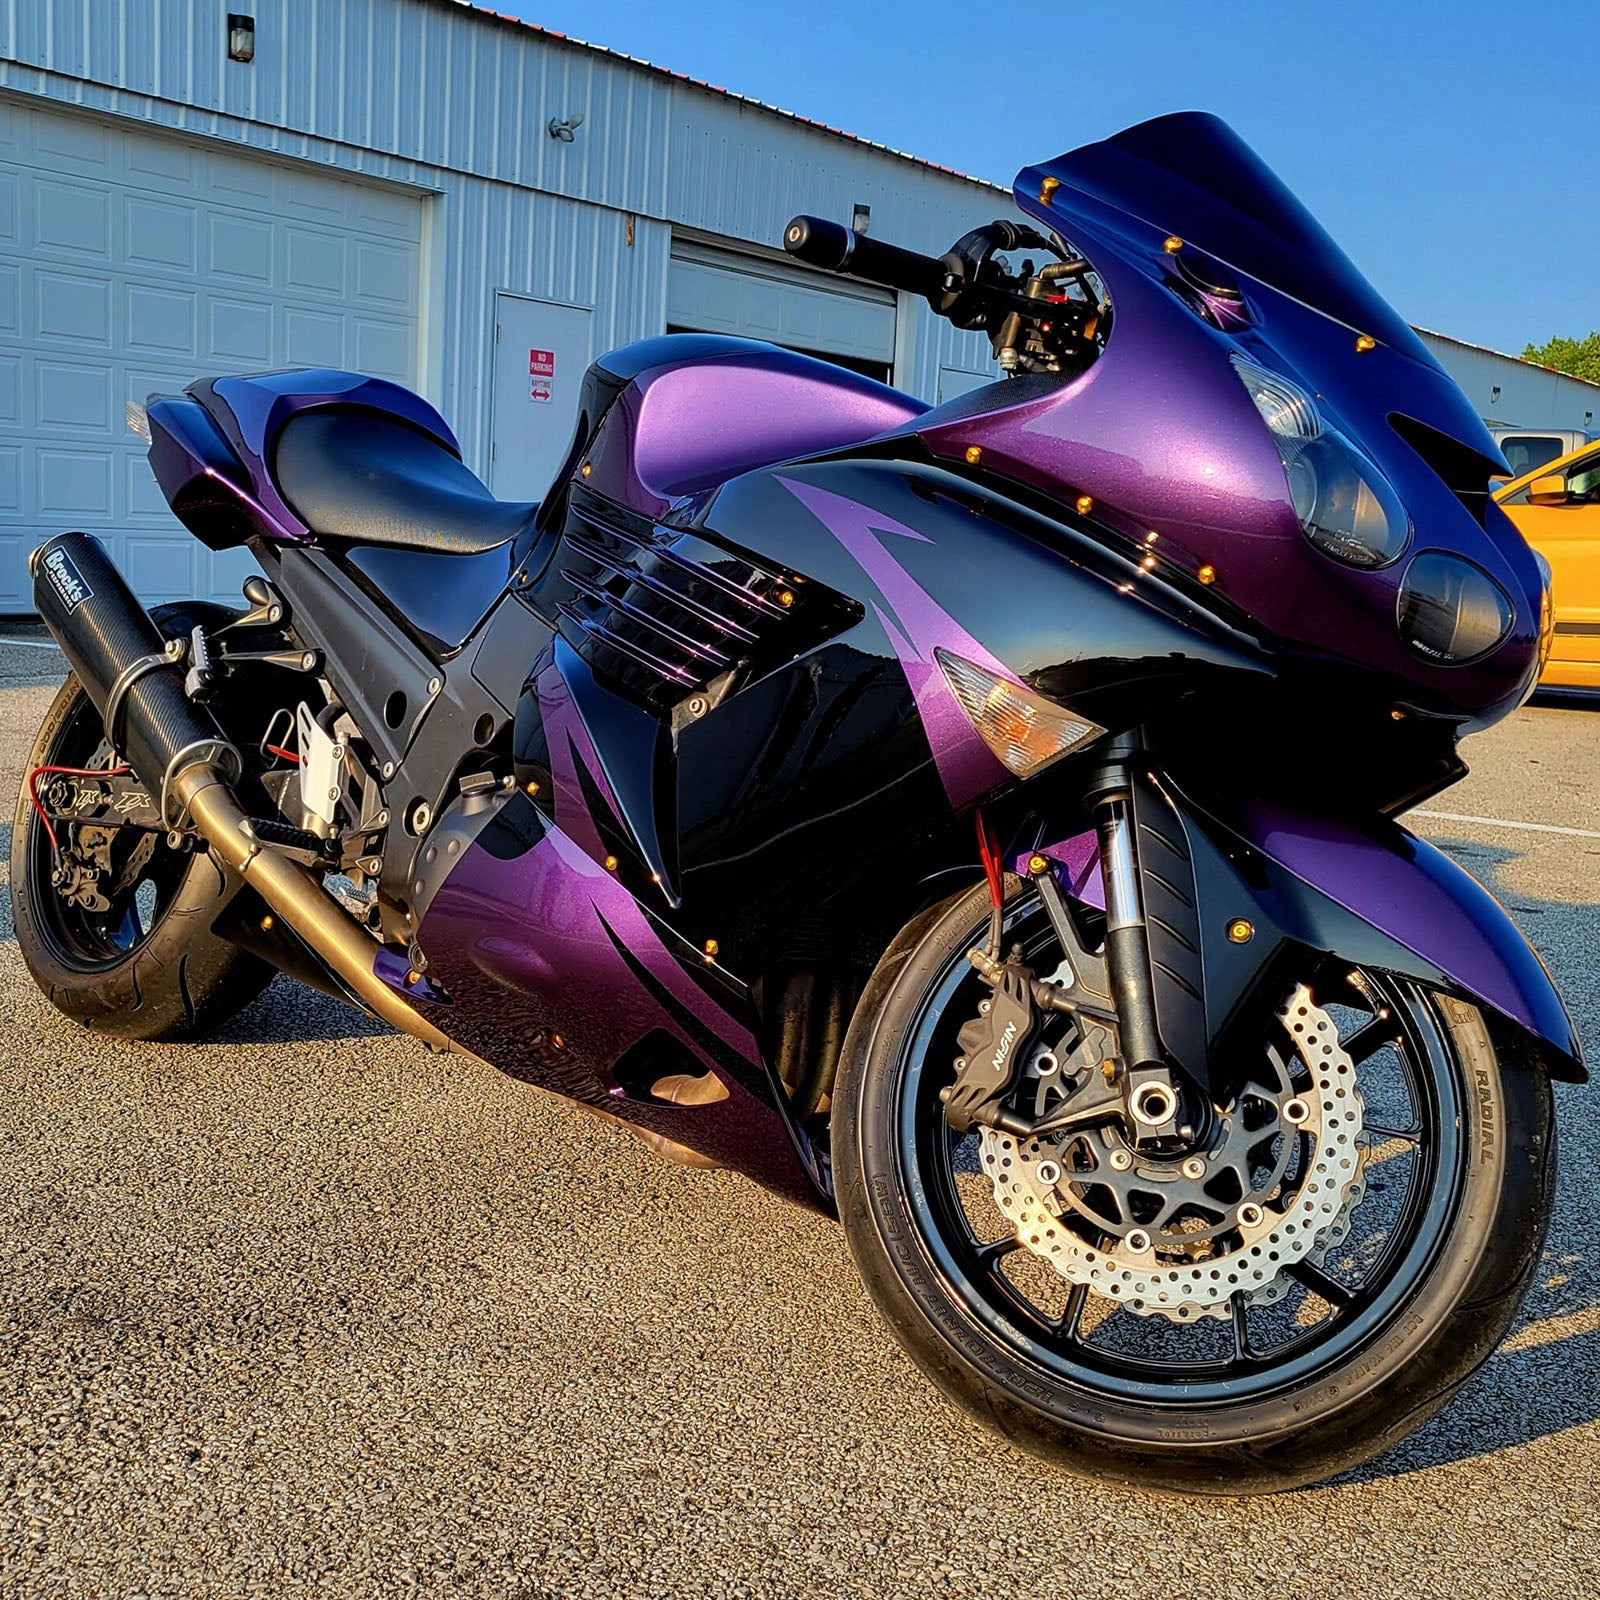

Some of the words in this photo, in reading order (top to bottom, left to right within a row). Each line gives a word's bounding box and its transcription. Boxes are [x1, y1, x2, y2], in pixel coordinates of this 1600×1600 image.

[530, 361, 553, 373] PARKING
[537, 352, 548, 363] NO
[531, 379, 552, 389] ANYTIME
[45, 550, 83, 602] Brock's
[991, 1020, 1017, 1072] NISSIN
[1475, 1069, 1495, 1165] RADIAL
